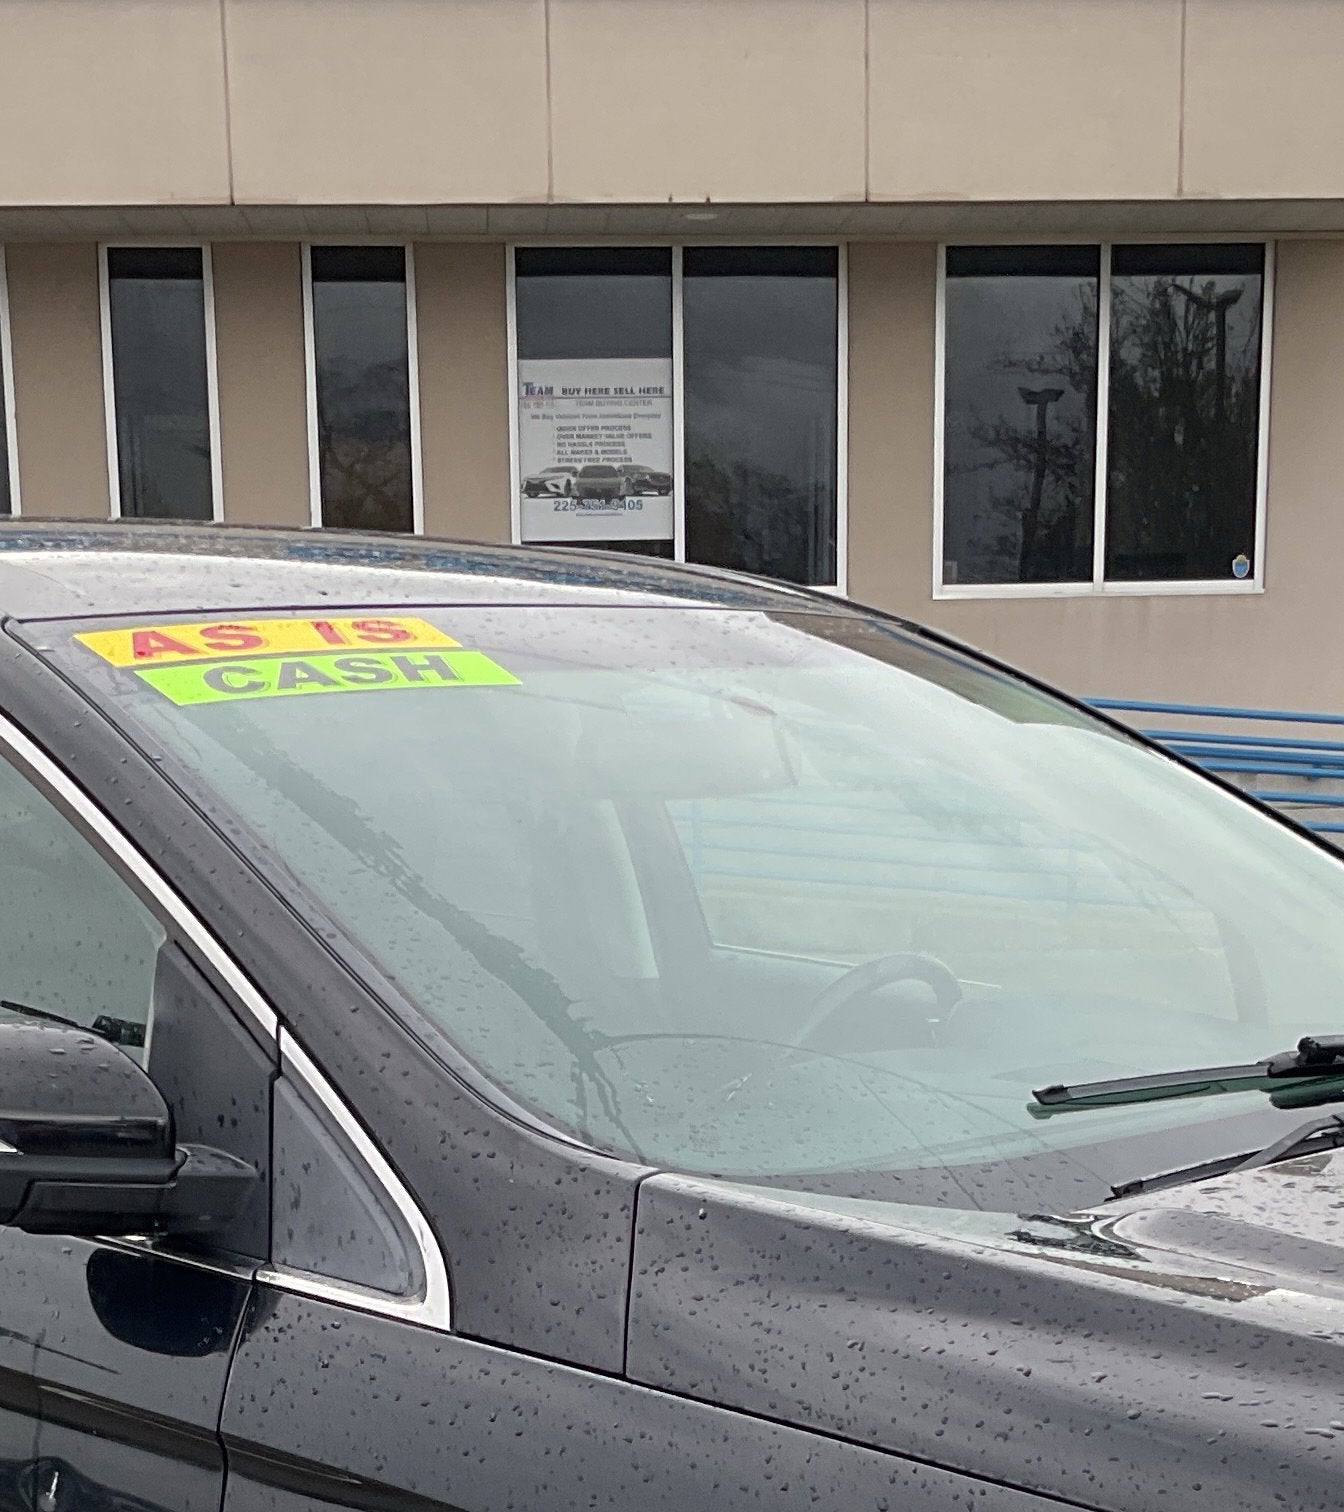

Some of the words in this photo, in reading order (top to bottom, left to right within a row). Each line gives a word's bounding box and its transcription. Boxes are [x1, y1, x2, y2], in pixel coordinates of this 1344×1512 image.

[522, 382, 554, 395] TEAM
[561, 387, 582, 396] BUY
[584, 387, 610, 396] HERE
[614, 387, 636, 395] SELL
[639, 386, 665, 395] HERE
[131, 623, 264, 660] AS
[309, 618, 410, 647] IS
[202, 655, 459, 694] CASH
